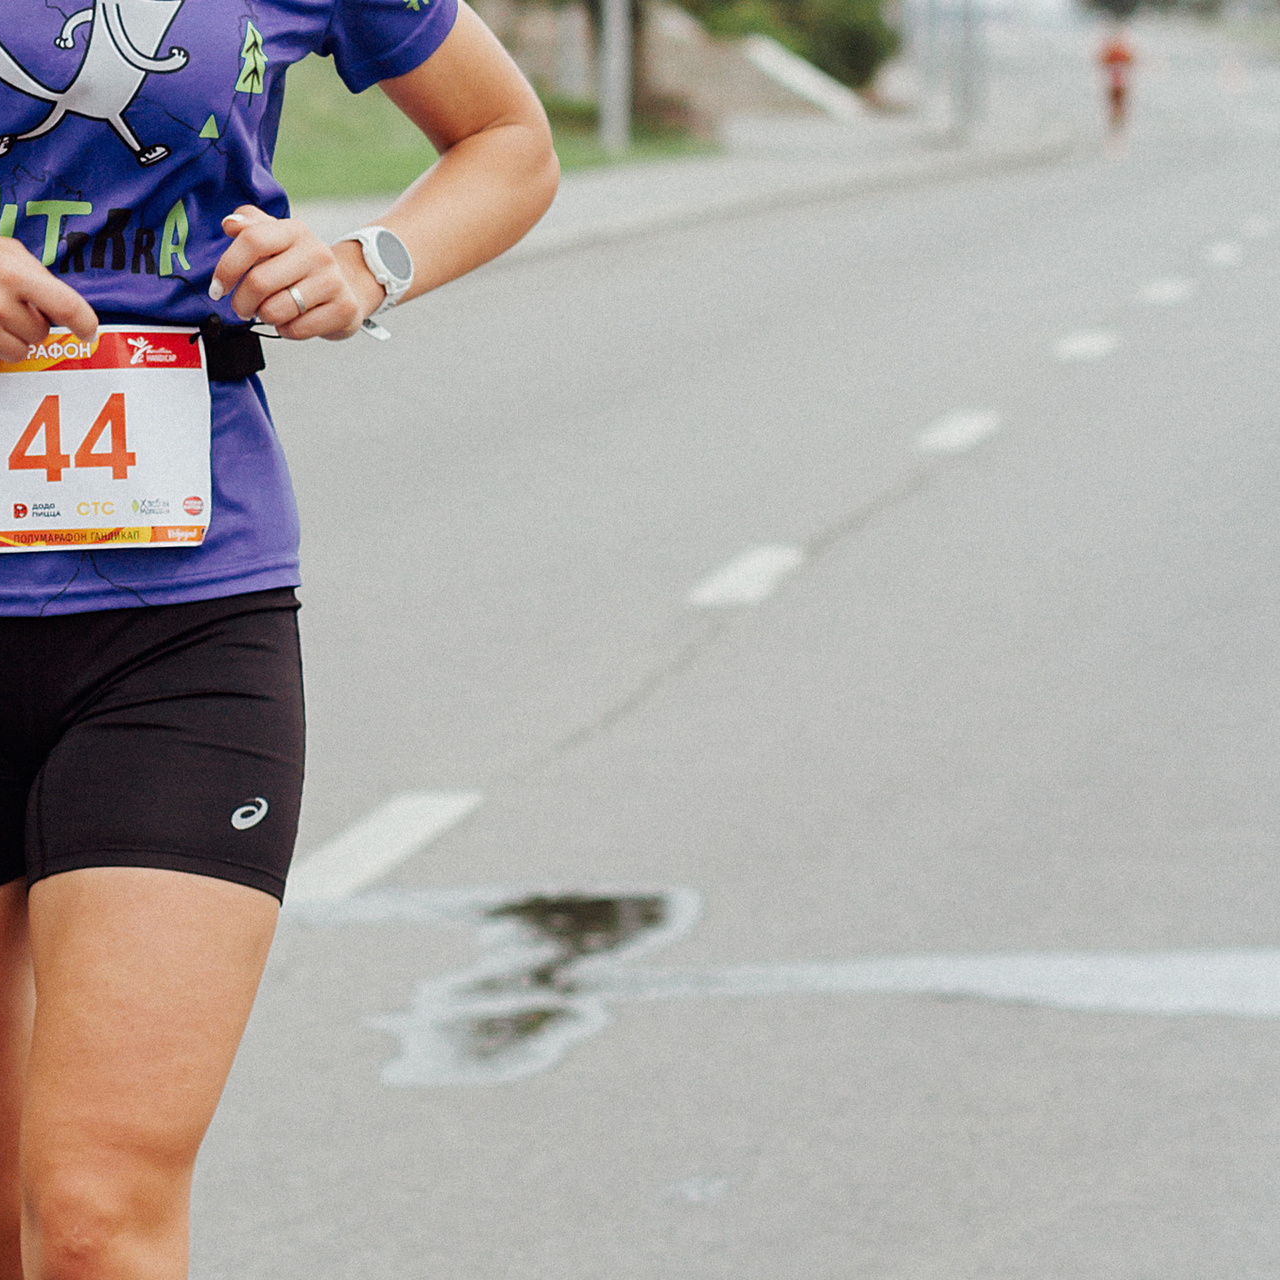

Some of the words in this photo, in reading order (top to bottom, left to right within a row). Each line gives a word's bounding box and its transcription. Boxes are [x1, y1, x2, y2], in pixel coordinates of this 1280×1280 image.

[8, 392, 136, 482] 44
[31, 510, 62, 518] ПИЦЦА
[77, 501, 115, 516] СТС
[13, 531, 88, 543] ПОЛУМАРАФОН
[90, 530, 140, 541] ГАНДИКАП
